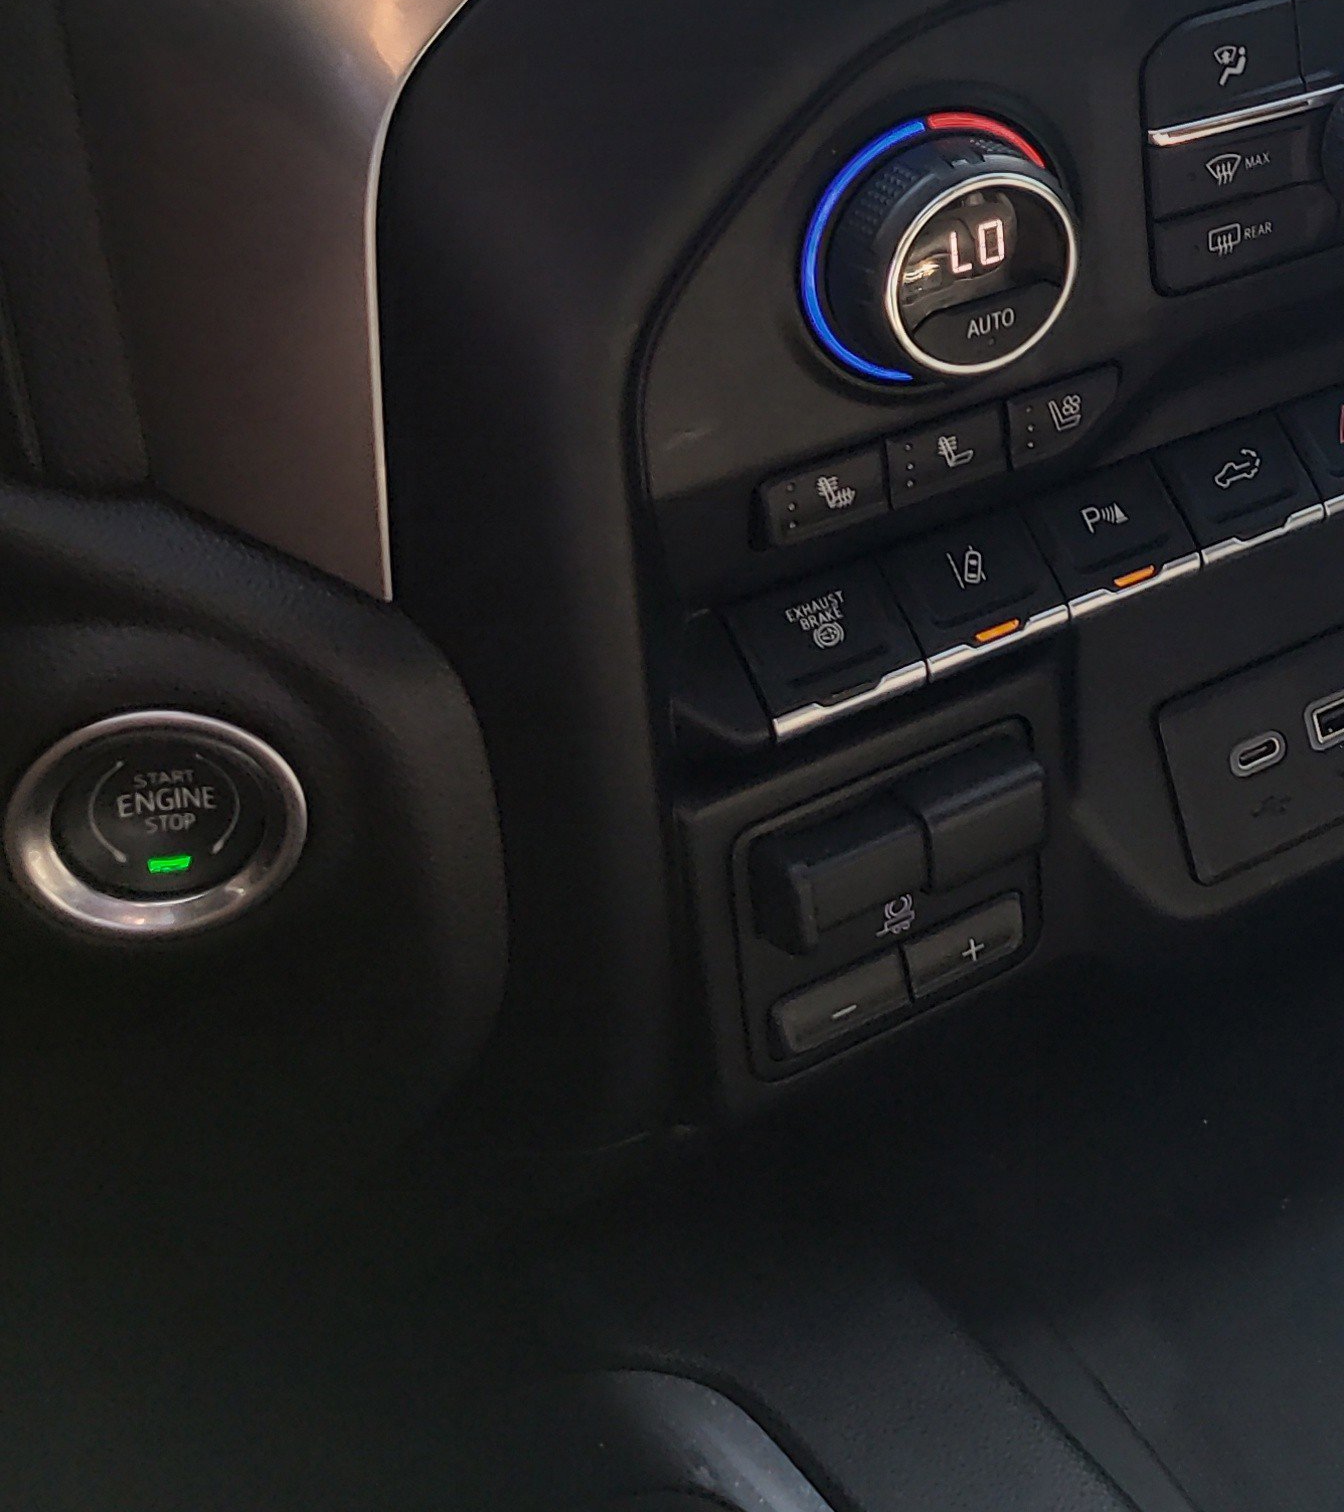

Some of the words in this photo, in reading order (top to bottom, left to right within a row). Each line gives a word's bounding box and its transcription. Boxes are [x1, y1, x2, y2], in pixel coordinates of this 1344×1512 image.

[1244, 152, 1271, 170] MAX
[1243, 221, 1273, 240] REAR
[949, 219, 1005, 274] LO
[966, 307, 1015, 339] AUTO
[785, 590, 845, 624] EXHAUST
[799, 607, 844, 631] BRAKE
[133, 769, 195, 788] START
[116, 786, 218, 818] ENGINE
[144, 812, 197, 834] STOP
